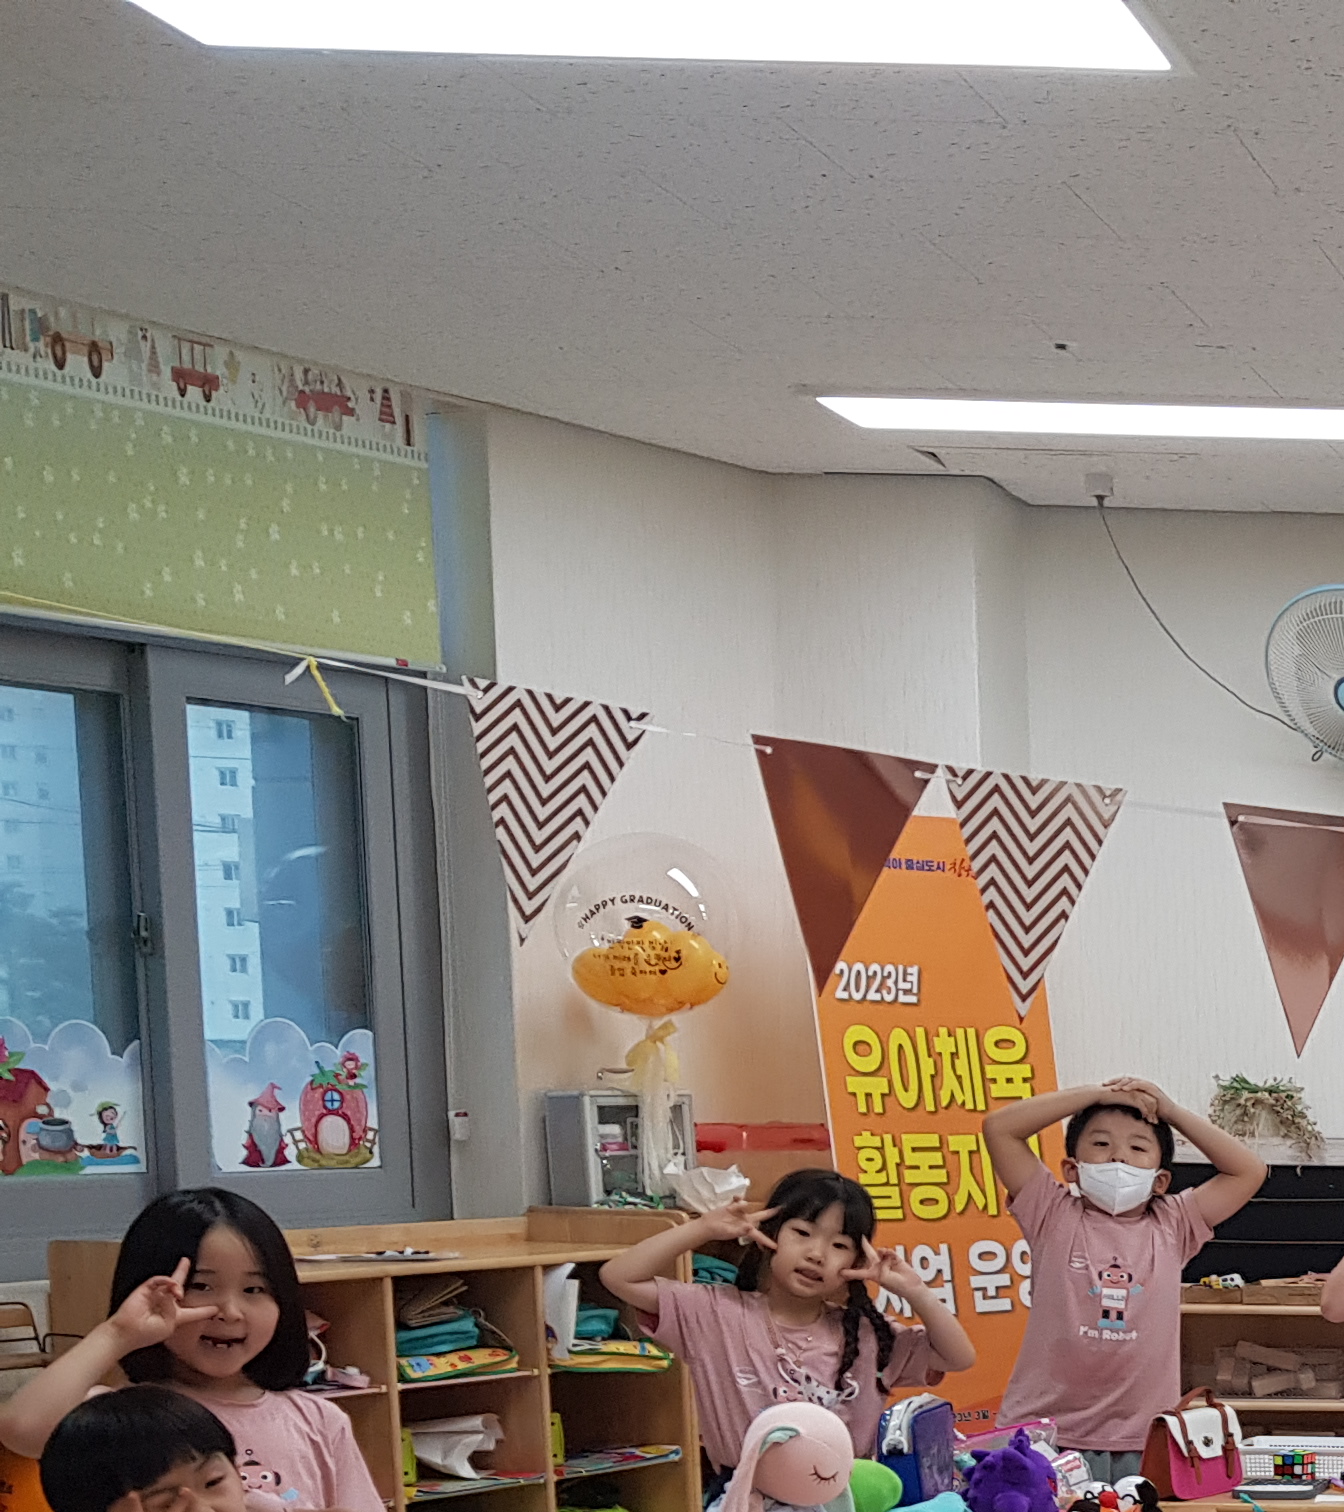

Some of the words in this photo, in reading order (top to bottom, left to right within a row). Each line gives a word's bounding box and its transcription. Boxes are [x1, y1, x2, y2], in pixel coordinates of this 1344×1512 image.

[619, 894, 694, 931] GRADUATION
[834, 960, 919, 1003] 2023년
[843, 1024, 1035, 1113] 유아체육
[853, 1130, 1042, 1220] 활동지
